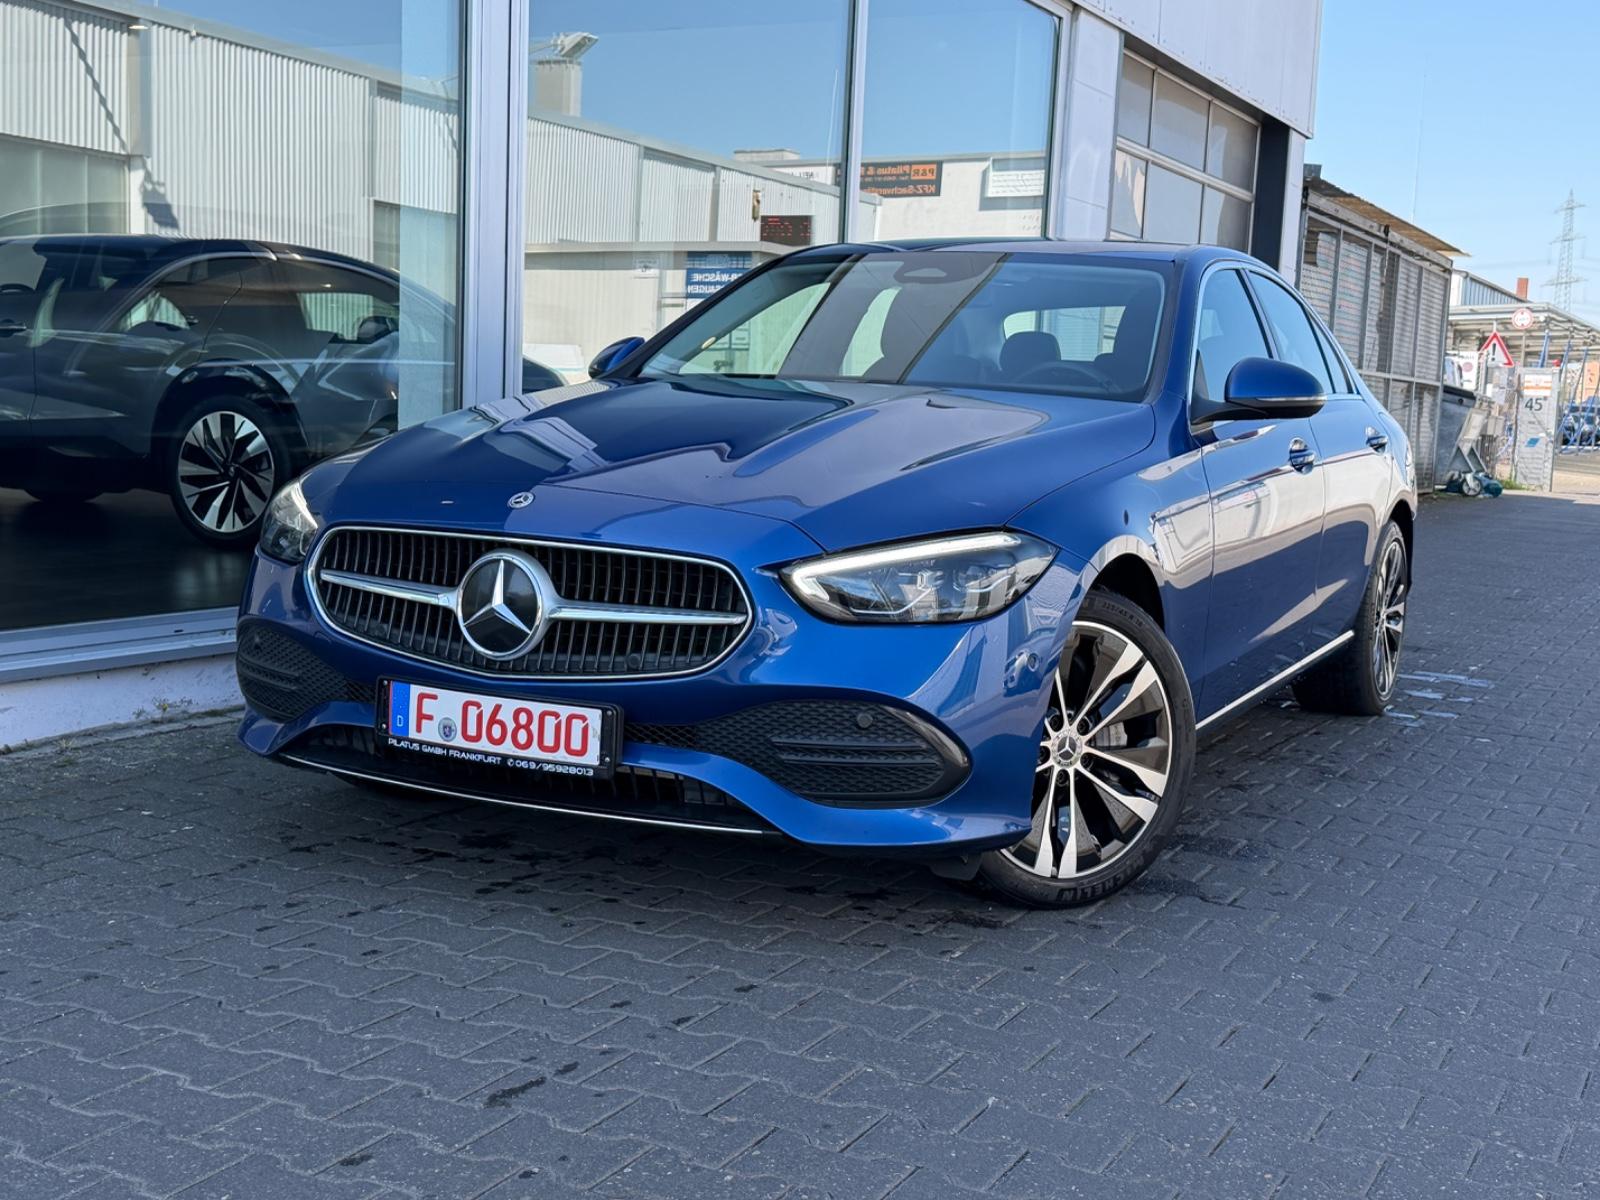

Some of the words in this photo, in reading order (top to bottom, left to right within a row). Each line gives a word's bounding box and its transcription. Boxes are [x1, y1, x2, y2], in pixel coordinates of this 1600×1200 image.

[1524, 397, 1543, 412] 45
[396, 715, 404, 727] D
[415, 692, 439, 734] F
[460, 699, 590, 757] 06800
[388, 737, 420, 752] PILATUS
[421, 744, 447, 757] GMBH
[448, 749, 502, 765] FRANKFURT
